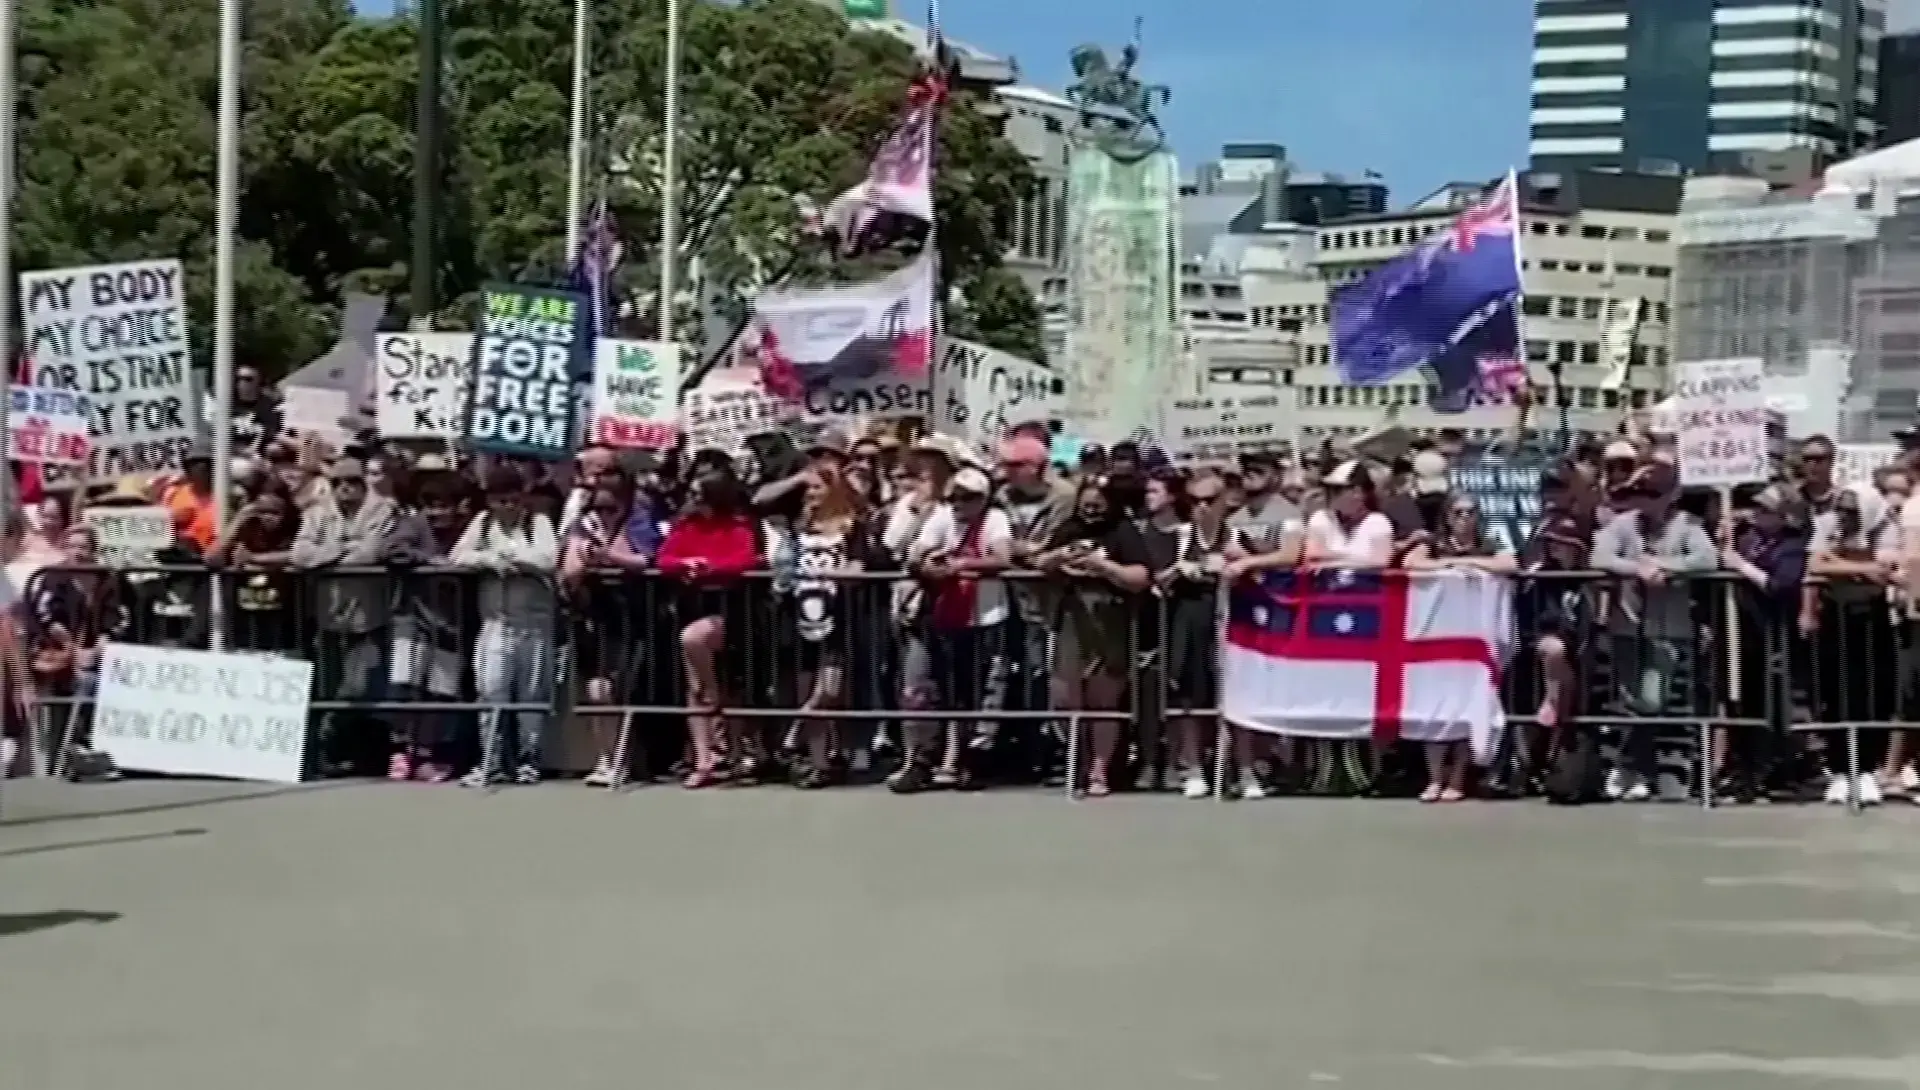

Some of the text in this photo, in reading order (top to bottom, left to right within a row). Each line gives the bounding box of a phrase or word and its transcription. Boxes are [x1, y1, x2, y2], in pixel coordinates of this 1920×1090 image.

[28, 269, 177, 313] MY BODY
[485, 292, 578, 322] WE ARE
[29, 308, 180, 357] MY CHOICE
[484, 316, 575, 344] VOICES
[37, 352, 185, 394] OR IS THAT
[483, 339, 570, 380] FOR
[941, 344, 988, 380] MY
[385, 380, 439, 405] for
[477, 376, 570, 415] FREE
[605, 373, 664, 400] HAVE
[127, 397, 184, 432] FOR
[945, 388, 970, 425] to
[1677, 407, 1765, 433] SACKING
[472, 411, 566, 448] DOM
[108, 656, 146, 688] NO
[149, 661, 201, 695] JAB
[156, 707, 208, 743] GOD
[218, 712, 253, 746] NO
